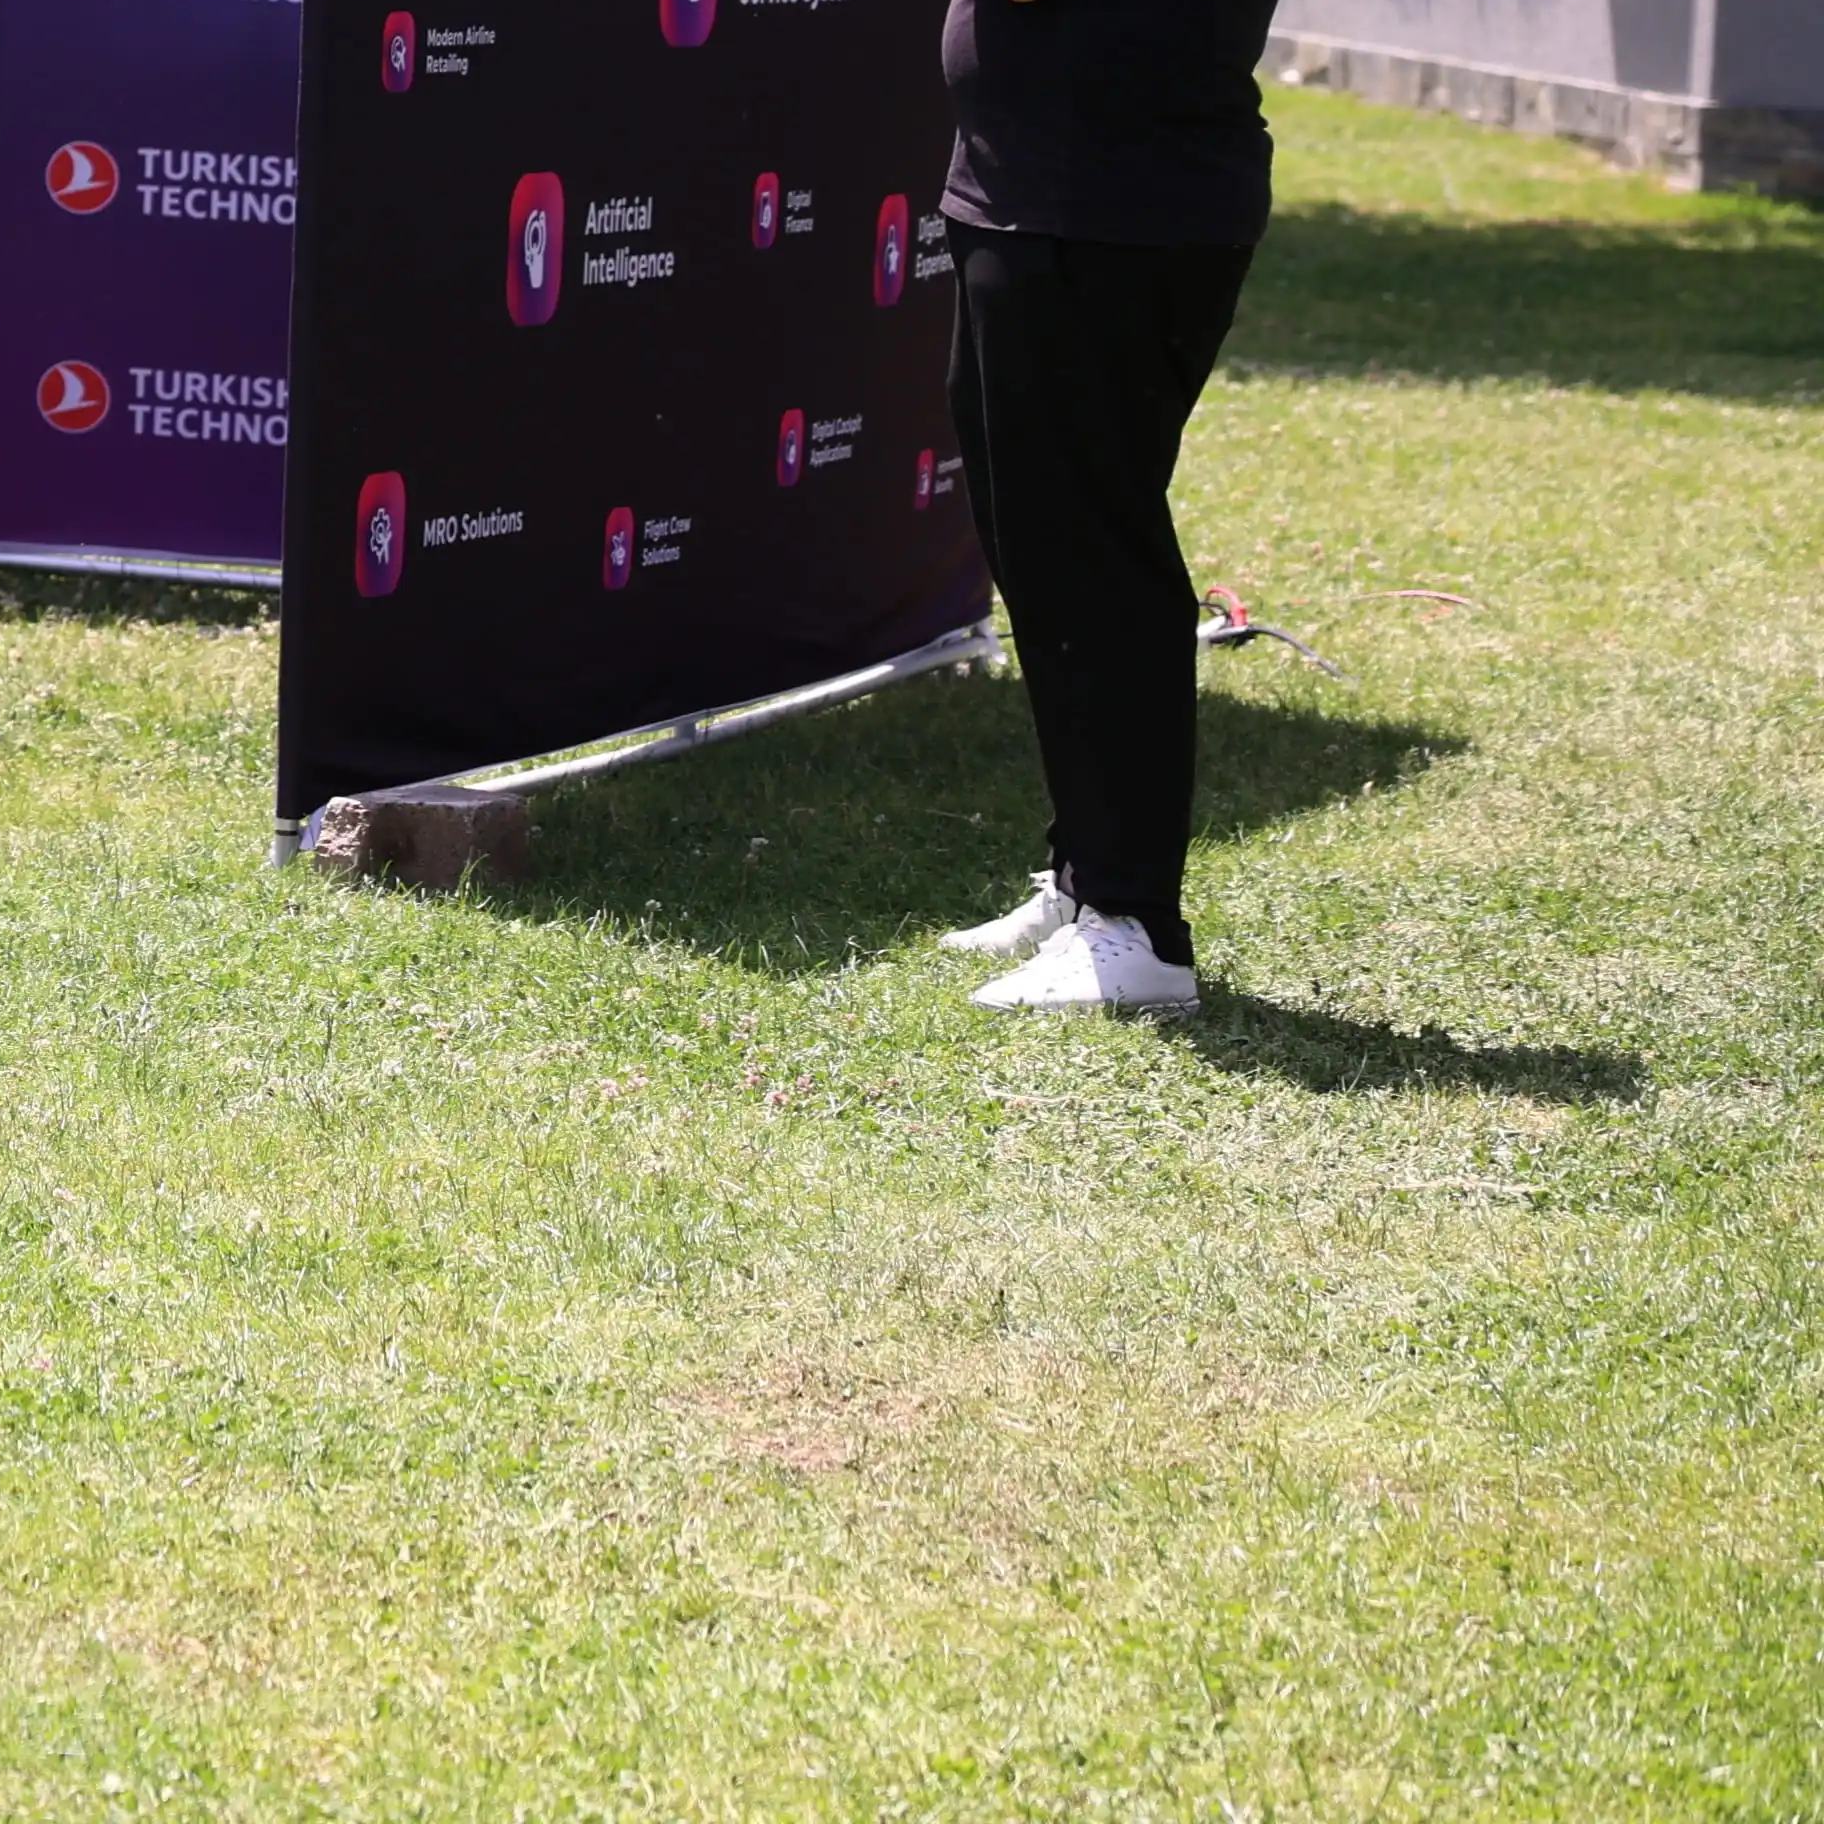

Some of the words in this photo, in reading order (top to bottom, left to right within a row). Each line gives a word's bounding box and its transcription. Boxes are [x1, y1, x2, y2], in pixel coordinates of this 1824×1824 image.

[426, 27, 464, 47] Modern
[464, 24, 496, 45] Airline
[425, 52, 469, 76] Retailing
[136, 185, 296, 225] TECHNO
[584, 196, 653, 236] Artificial
[582, 245, 675, 288] Intelligence
[128, 404, 288, 446] TECHNO
[422, 515, 459, 548] MRO
[460, 506, 524, 542] Solutions
[644, 519, 669, 543] Flight
[669, 515, 692, 535] Crew
[641, 543, 681, 567] Solutions
